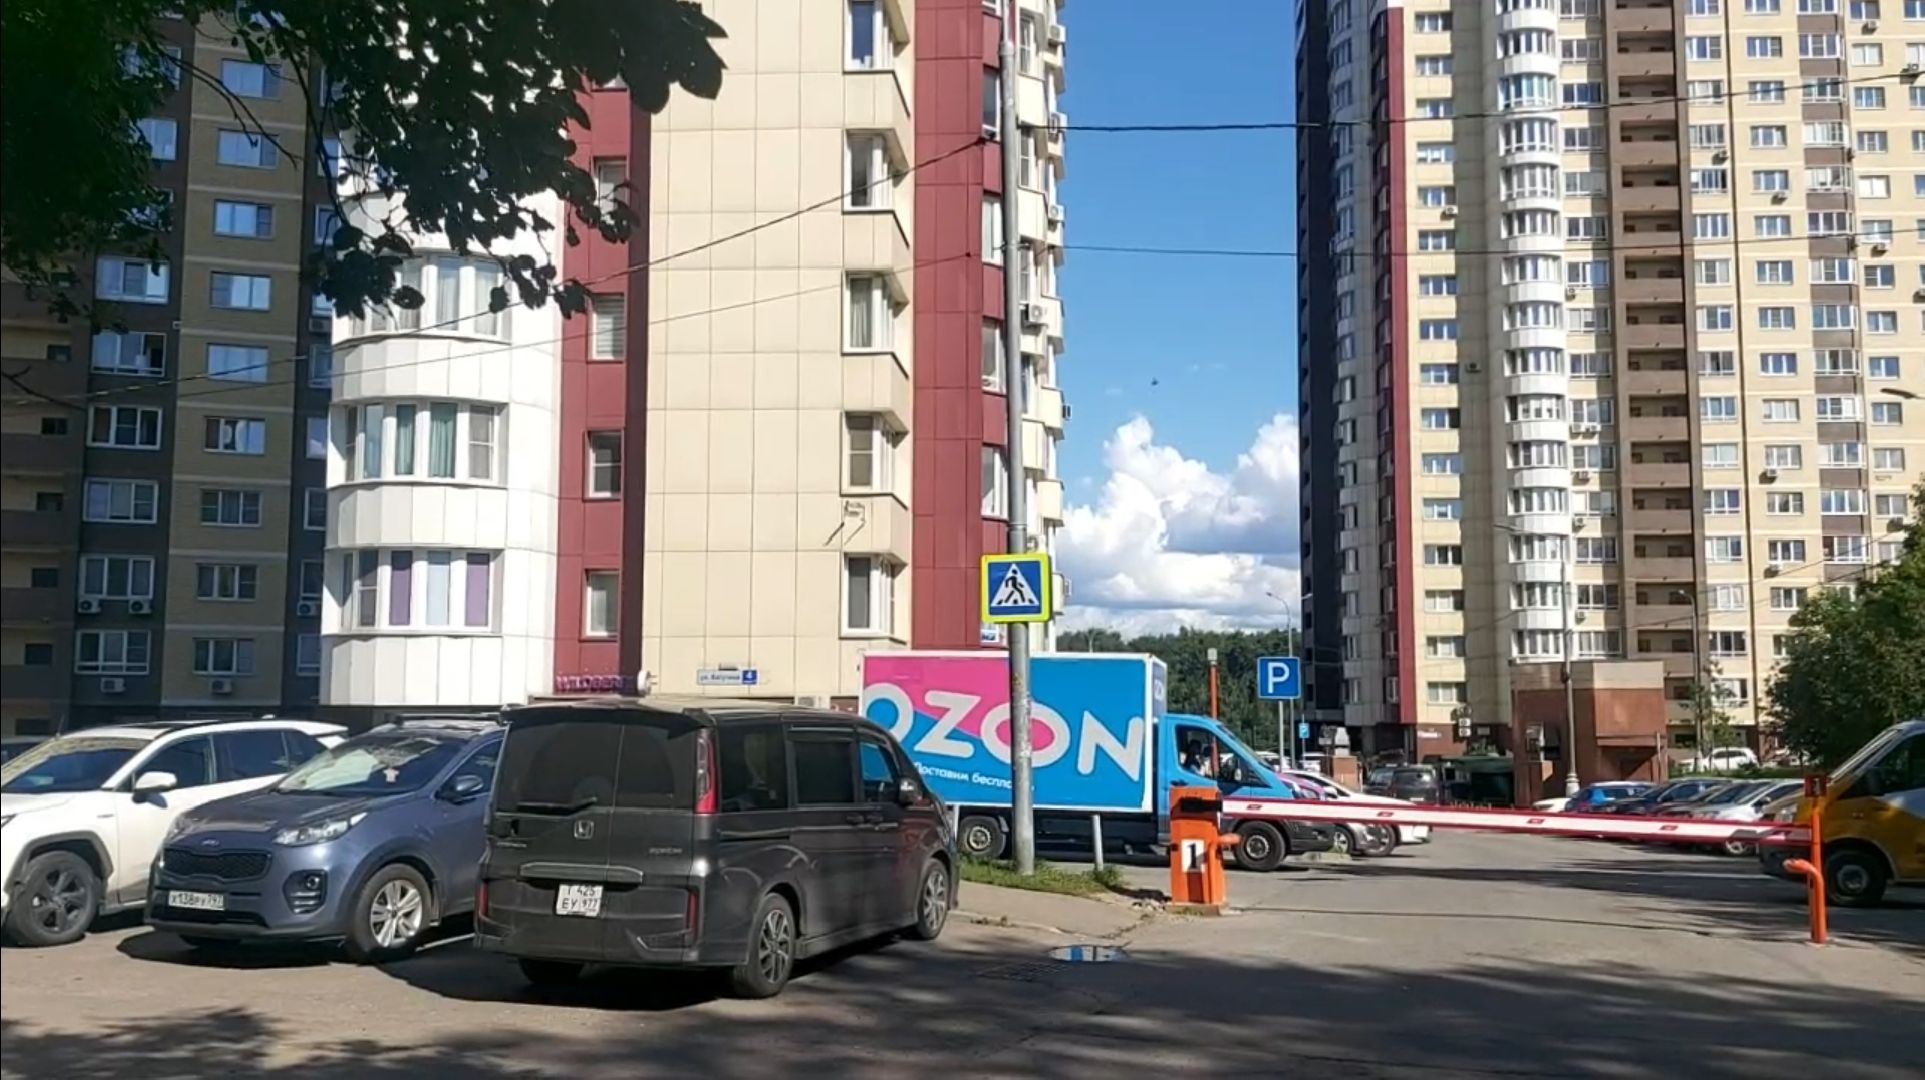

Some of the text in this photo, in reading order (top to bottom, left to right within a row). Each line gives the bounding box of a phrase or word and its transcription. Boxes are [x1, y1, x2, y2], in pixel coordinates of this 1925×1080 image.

[1268, 662, 1290, 694] P
[864, 682, 1144, 783] OZON
[1186, 843, 1197, 869] 1
